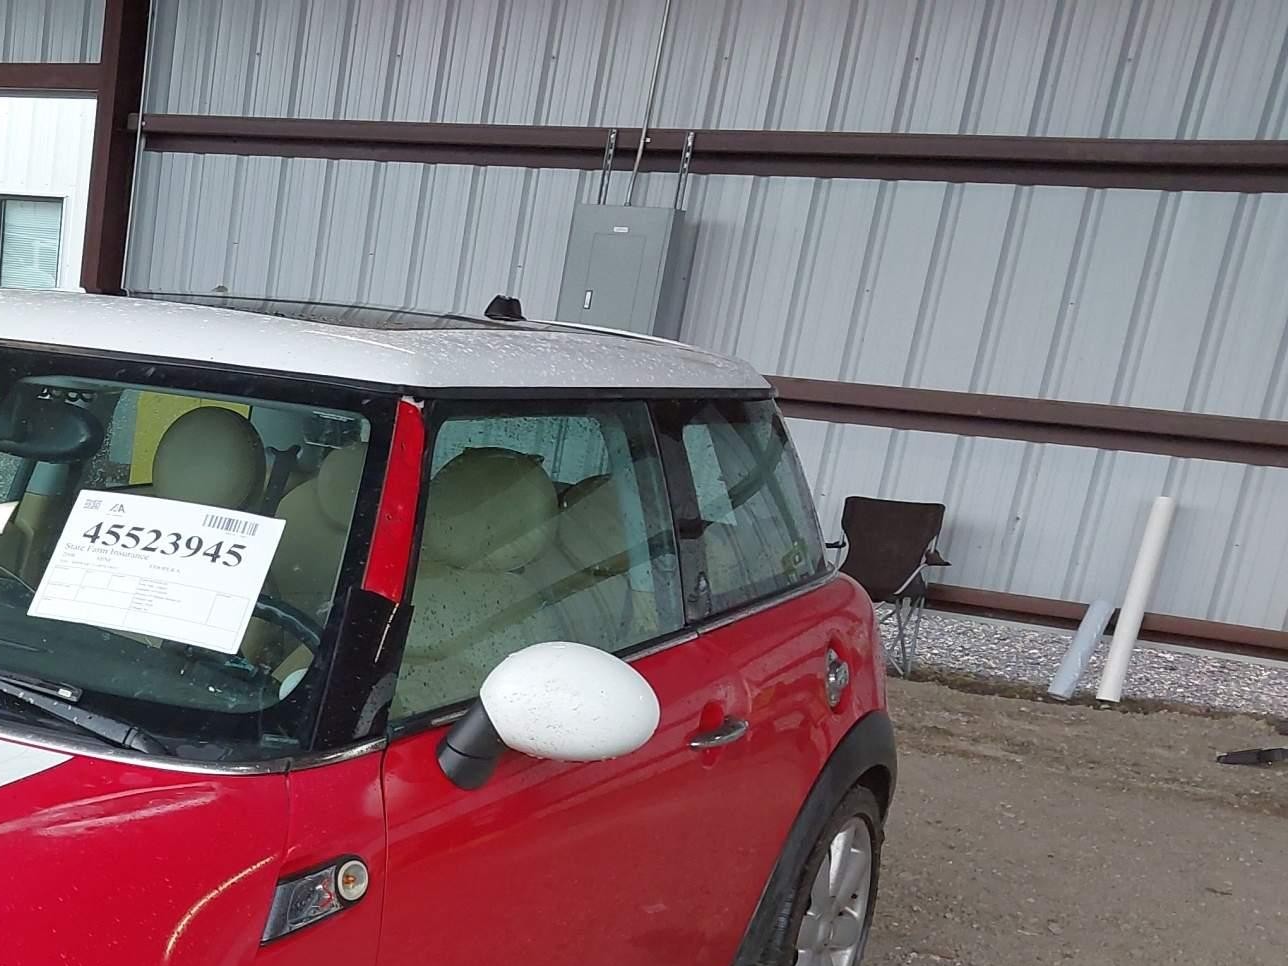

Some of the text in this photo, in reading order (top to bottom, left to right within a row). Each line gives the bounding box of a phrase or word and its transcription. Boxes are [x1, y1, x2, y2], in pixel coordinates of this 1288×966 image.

[64, 542, 86, 552] State
[86, 545, 109, 555] Farm
[110, 548, 150, 561] Insurance
[83, 521, 247, 567] 45523945
